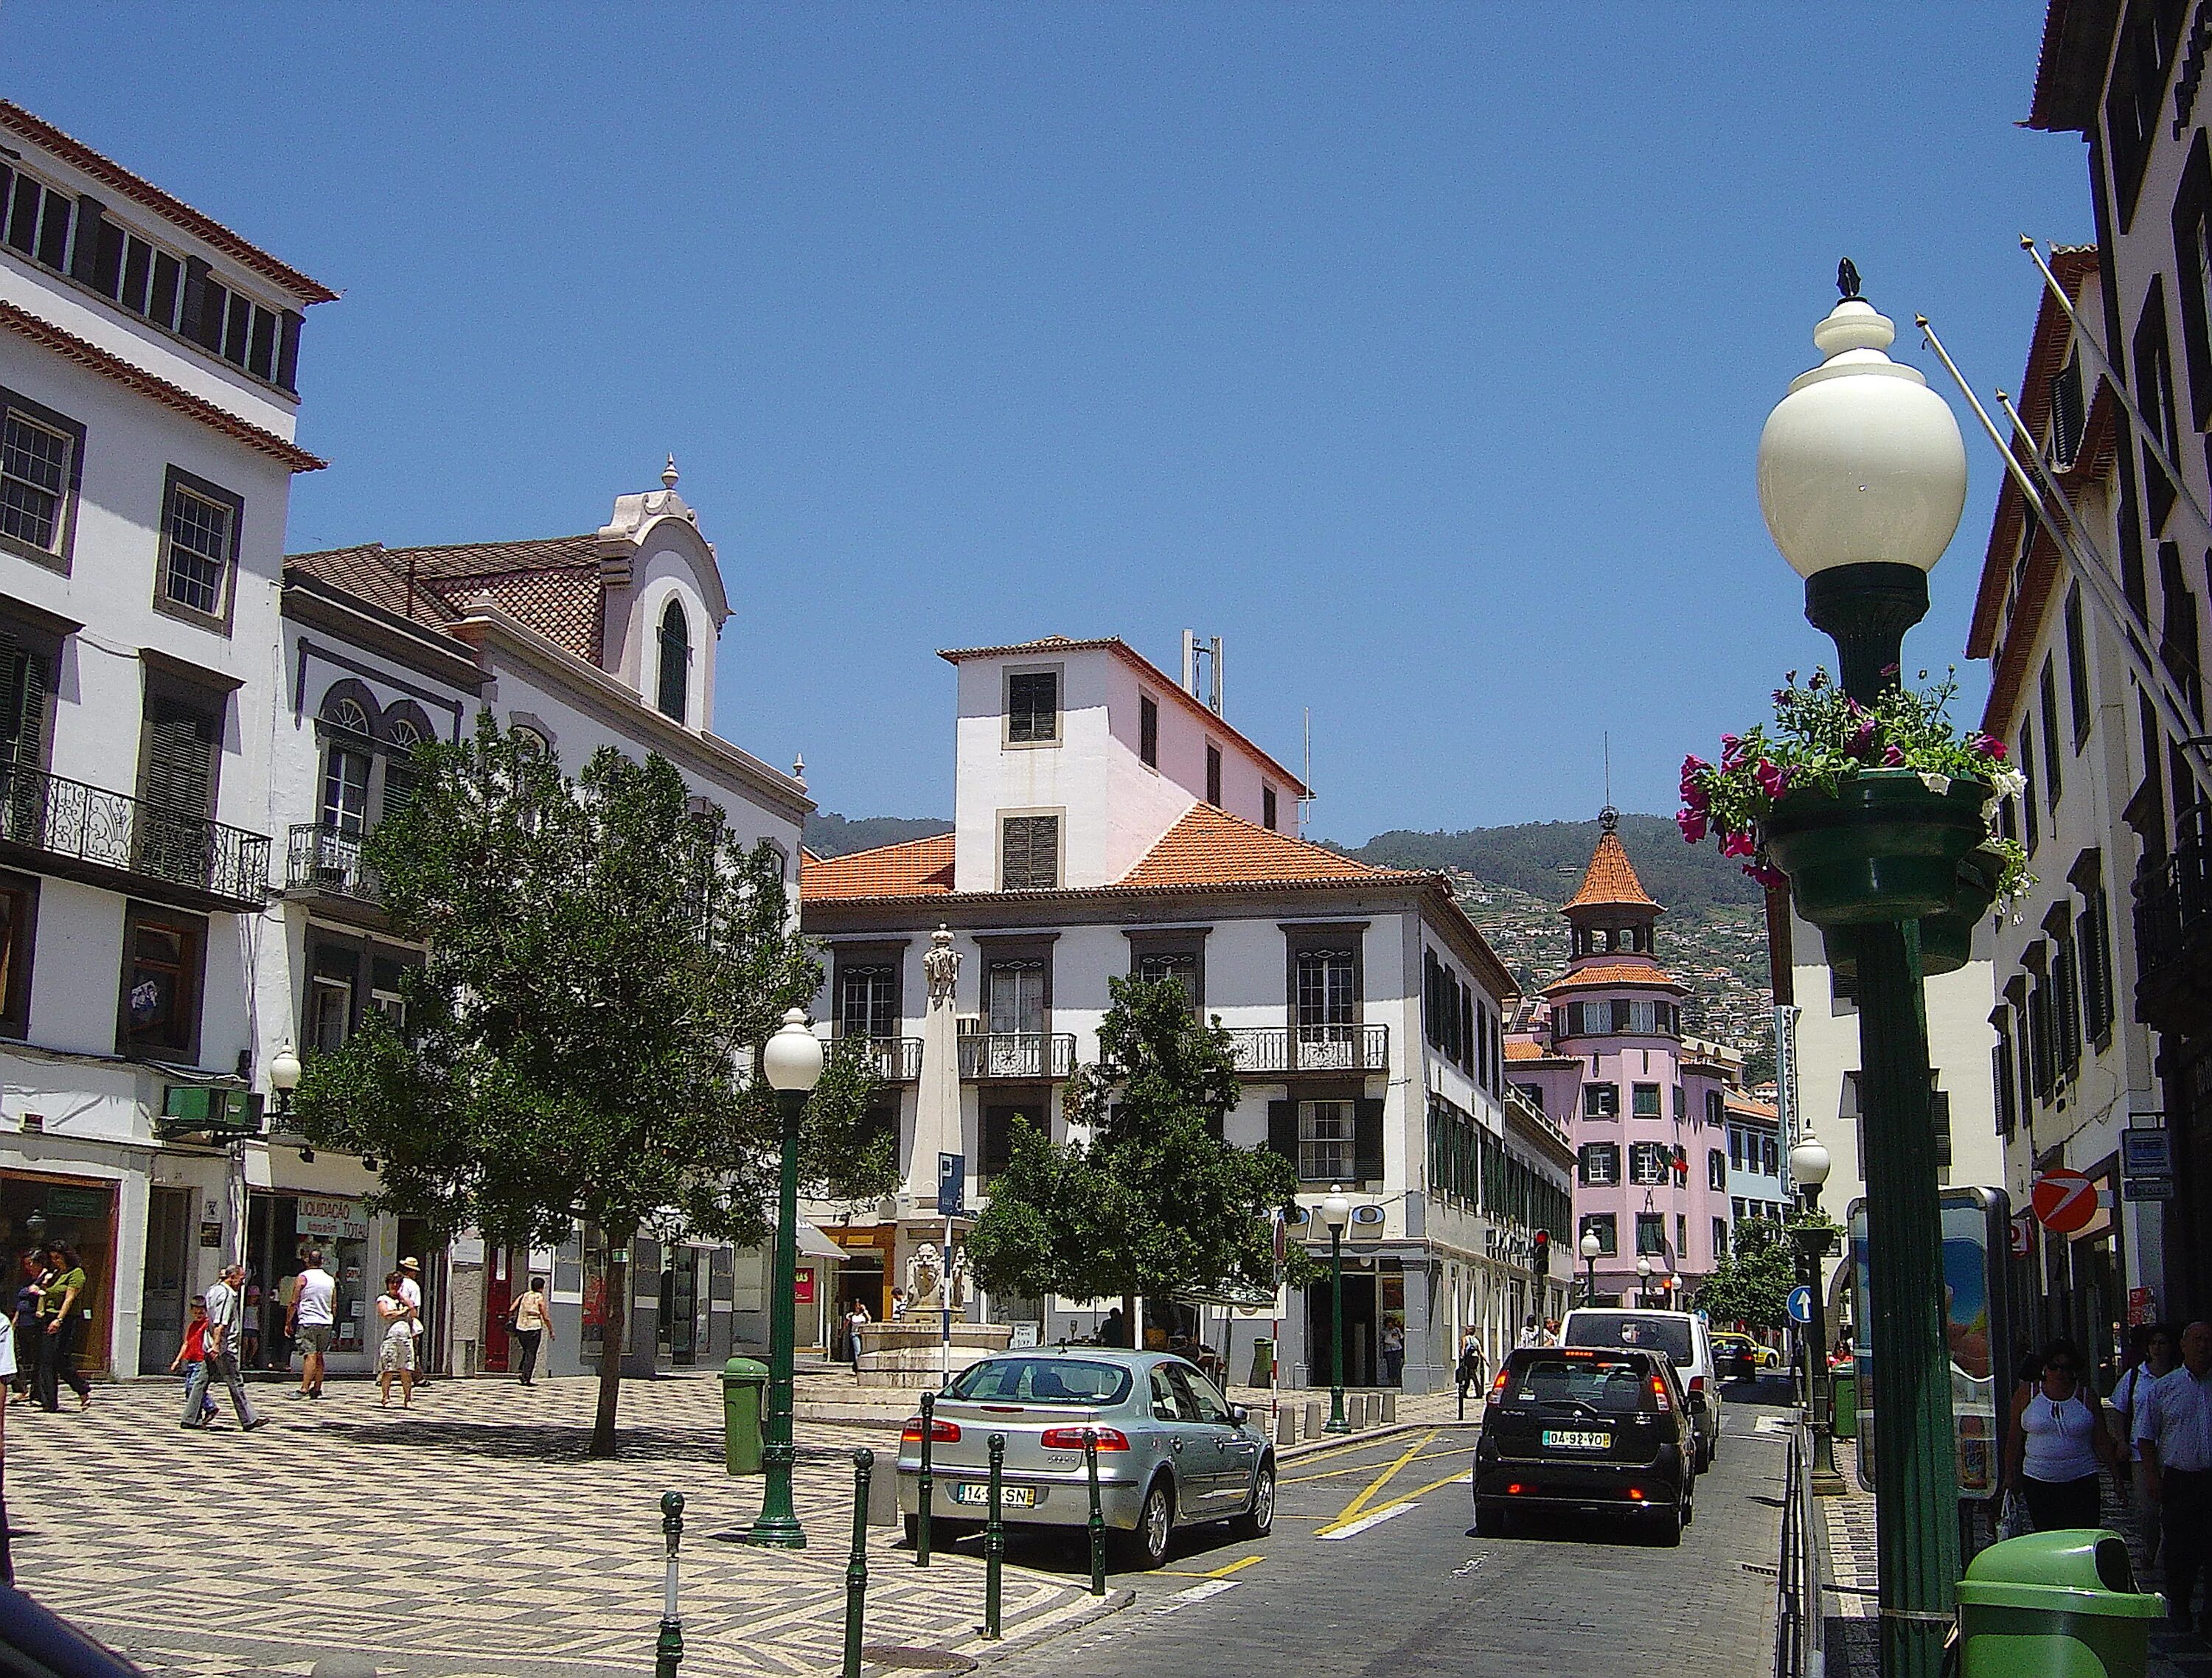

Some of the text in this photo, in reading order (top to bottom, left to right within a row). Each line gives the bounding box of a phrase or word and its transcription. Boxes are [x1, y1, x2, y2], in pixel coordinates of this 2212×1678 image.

[299, 1199, 350, 1221] LIQUIDAÇÃO
[344, 1222, 369, 1239] TOTAL
[968, 1486, 1026, 1503] 14--SN
